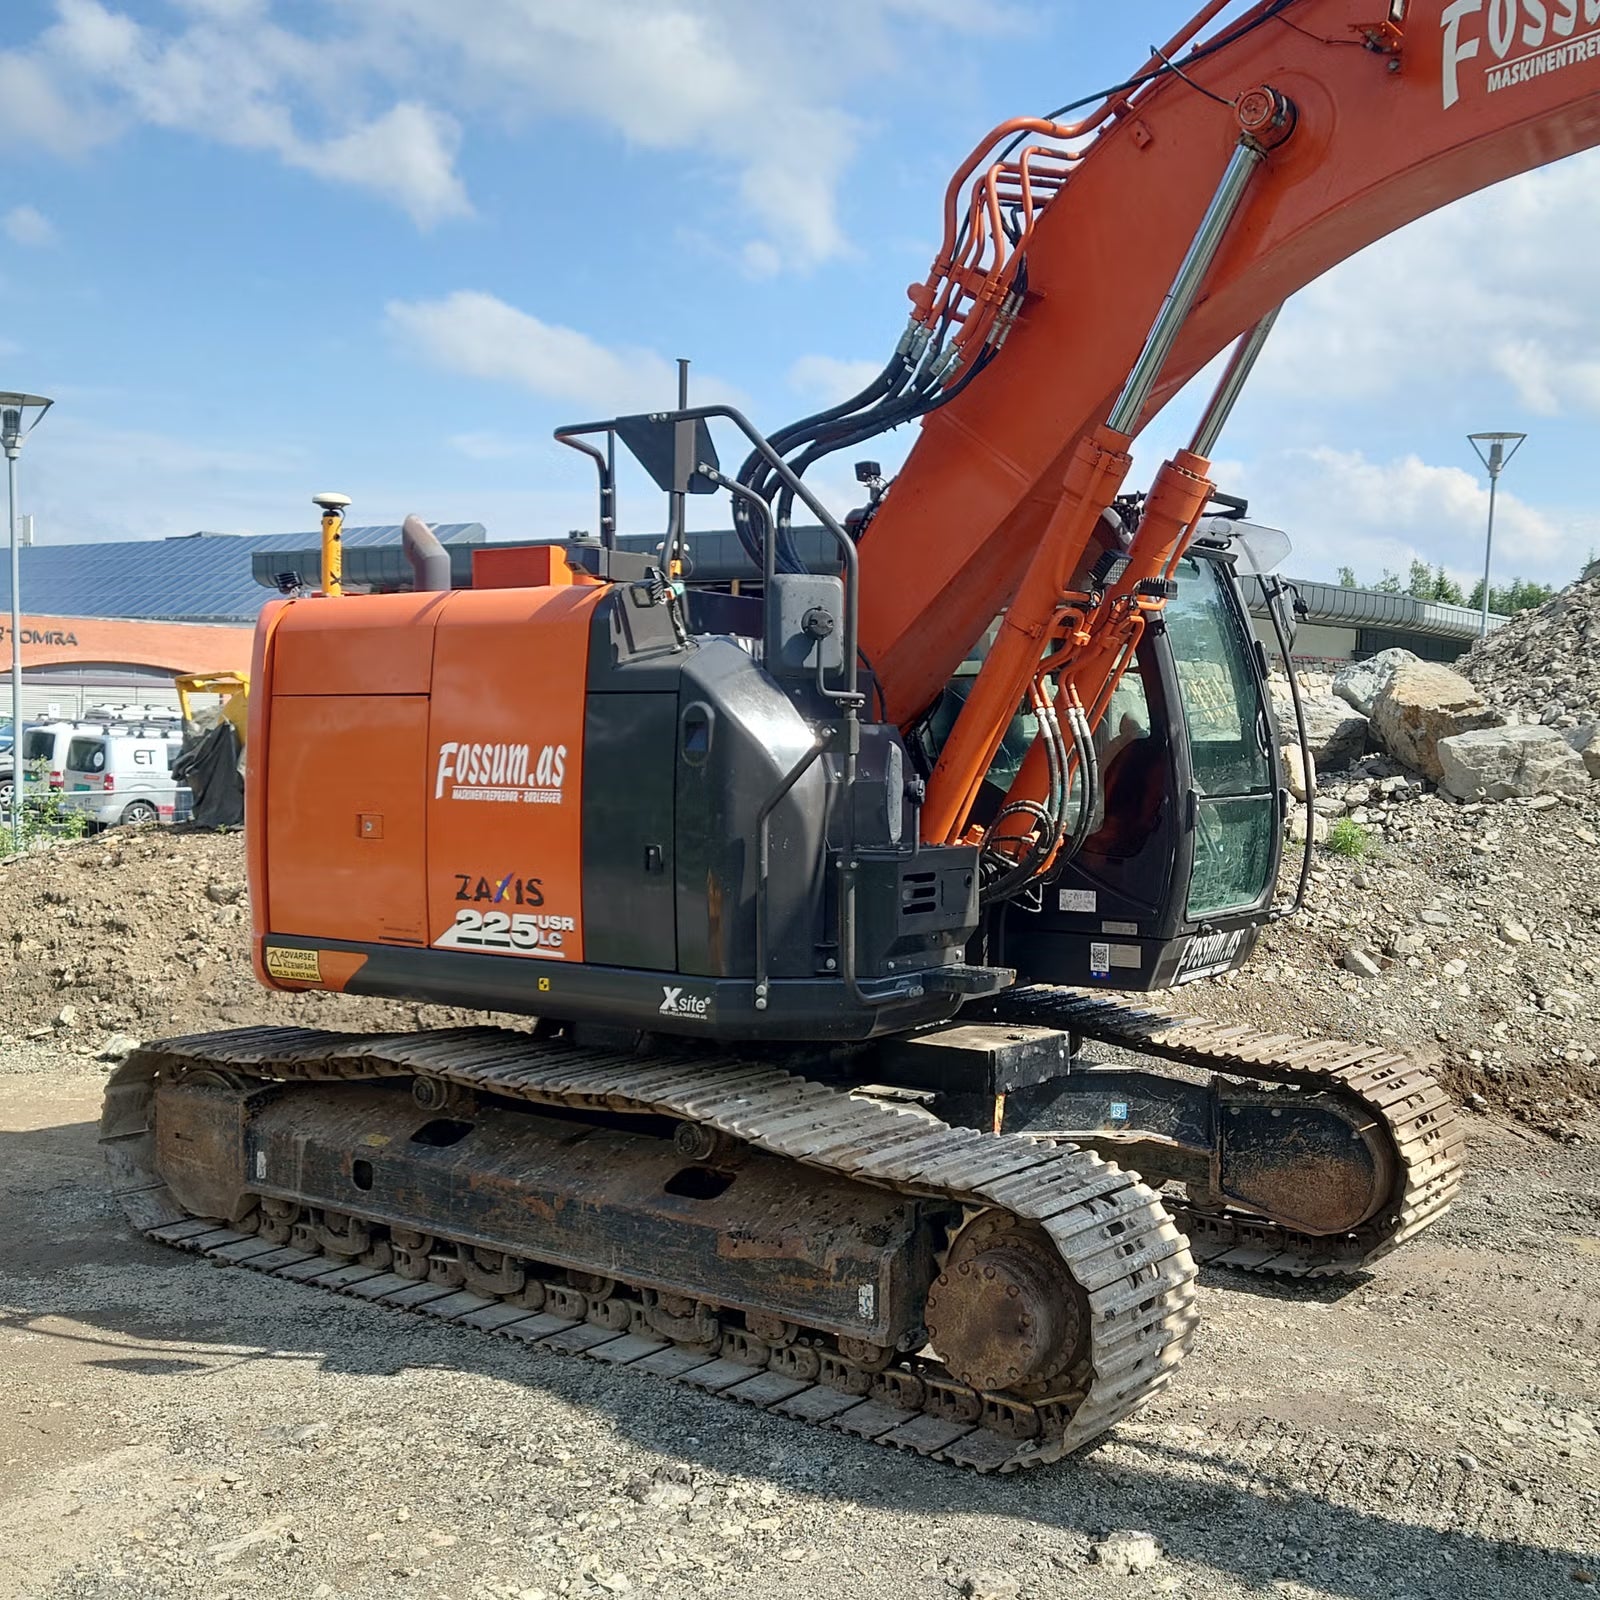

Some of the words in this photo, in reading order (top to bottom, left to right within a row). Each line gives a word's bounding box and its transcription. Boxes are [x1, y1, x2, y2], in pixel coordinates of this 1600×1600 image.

[133, 749, 157, 765] ET
[454, 872, 545, 907] ZAXIS
[455, 908, 539, 950] 225
[538, 915, 575, 931] USR
[538, 931, 563, 947] LC
[280, 950, 316, 961] ADVARSEL
